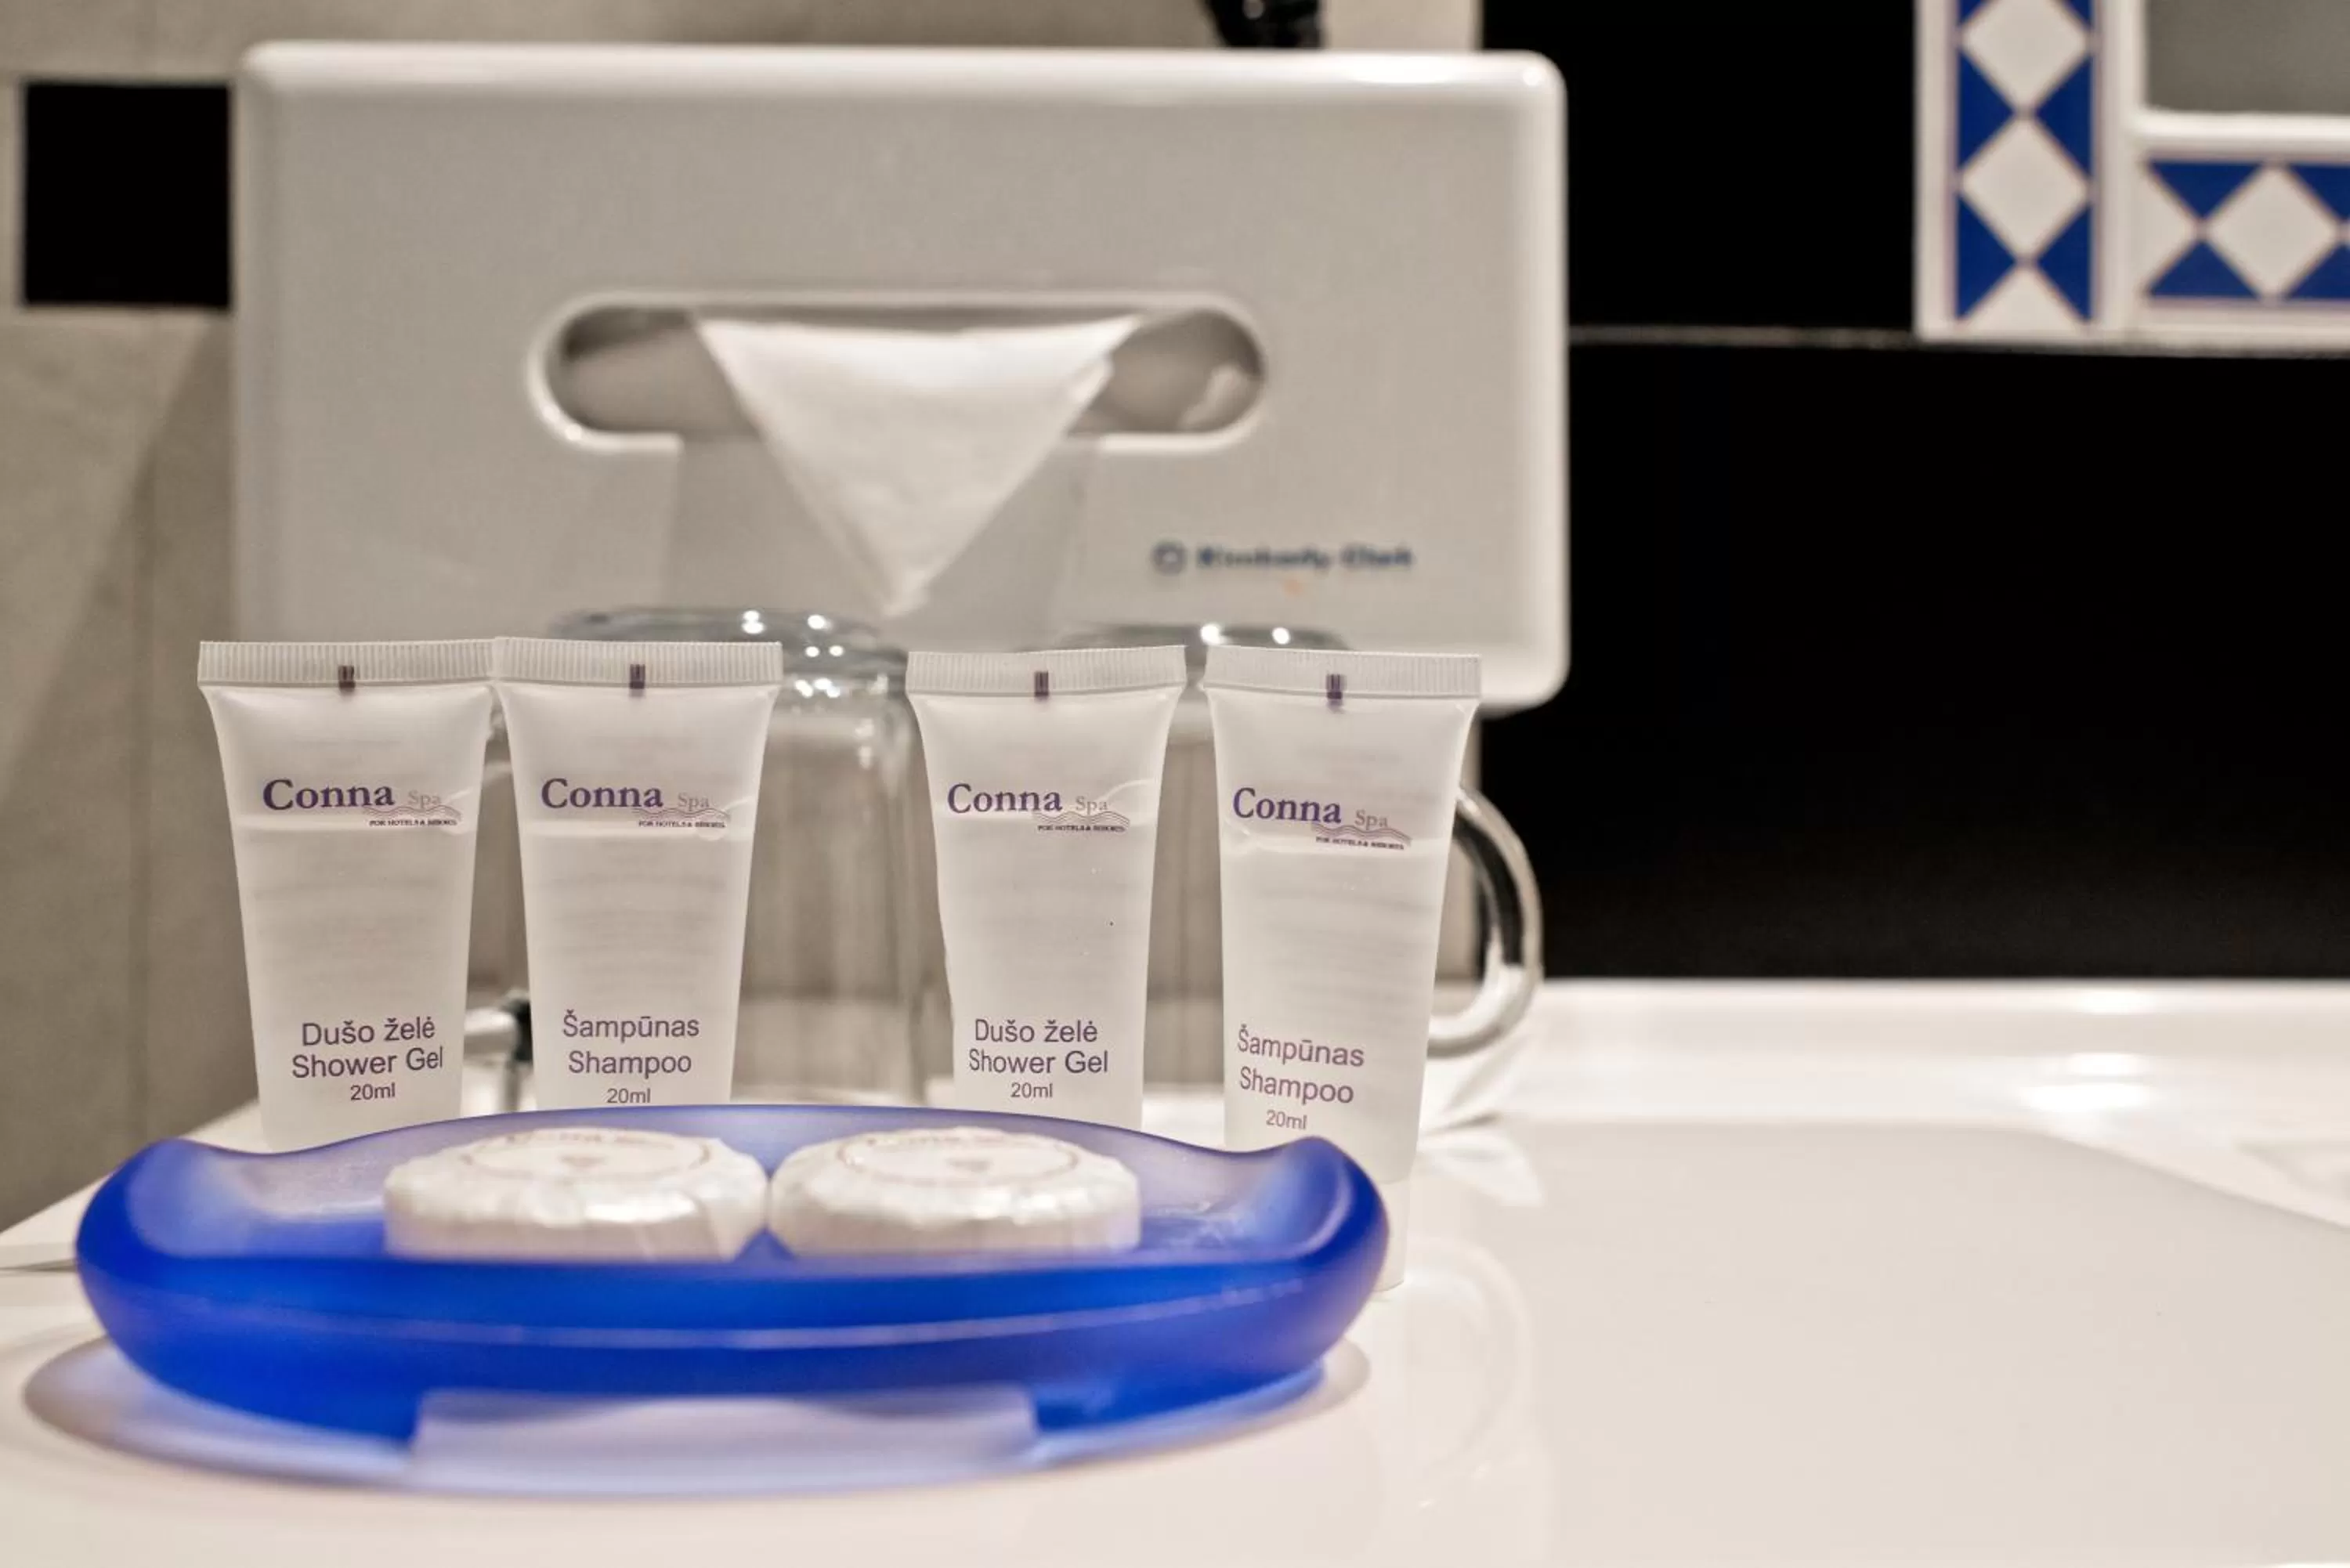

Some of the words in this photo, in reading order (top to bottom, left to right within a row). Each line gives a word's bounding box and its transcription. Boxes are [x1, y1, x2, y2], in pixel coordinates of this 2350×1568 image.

[262, 779, 395, 811] Conna
[407, 789, 443, 810] Spa
[540, 777, 664, 809] Conna
[677, 792, 710, 811] Spa
[947, 782, 1063, 814] Conna
[1074, 795, 1109, 815] Spa
[1232, 786, 1343, 824] Conna
[1354, 808, 1389, 830] Spa
[302, 1020, 375, 1046] Dušo
[383, 1016, 436, 1042] želė
[562, 1009, 700, 1044] Šampūnas
[974, 1019, 1035, 1043] Dušo
[1043, 1019, 1098, 1043] želė
[1237, 1023, 1365, 1068] Šampūnas
[291, 1053, 398, 1078] Shower
[406, 1046, 443, 1071] Gel
[568, 1050, 692, 1080] Shampoo
[968, 1048, 1057, 1075] Shower
[1065, 1050, 1108, 1075] Gel
[349, 1082, 396, 1101] 20ml
[606, 1087, 652, 1104] 20ml
[1010, 1082, 1054, 1098] 20ml
[1239, 1065, 1355, 1106] Shampoo
[1265, 1108, 1308, 1130] 20ml
